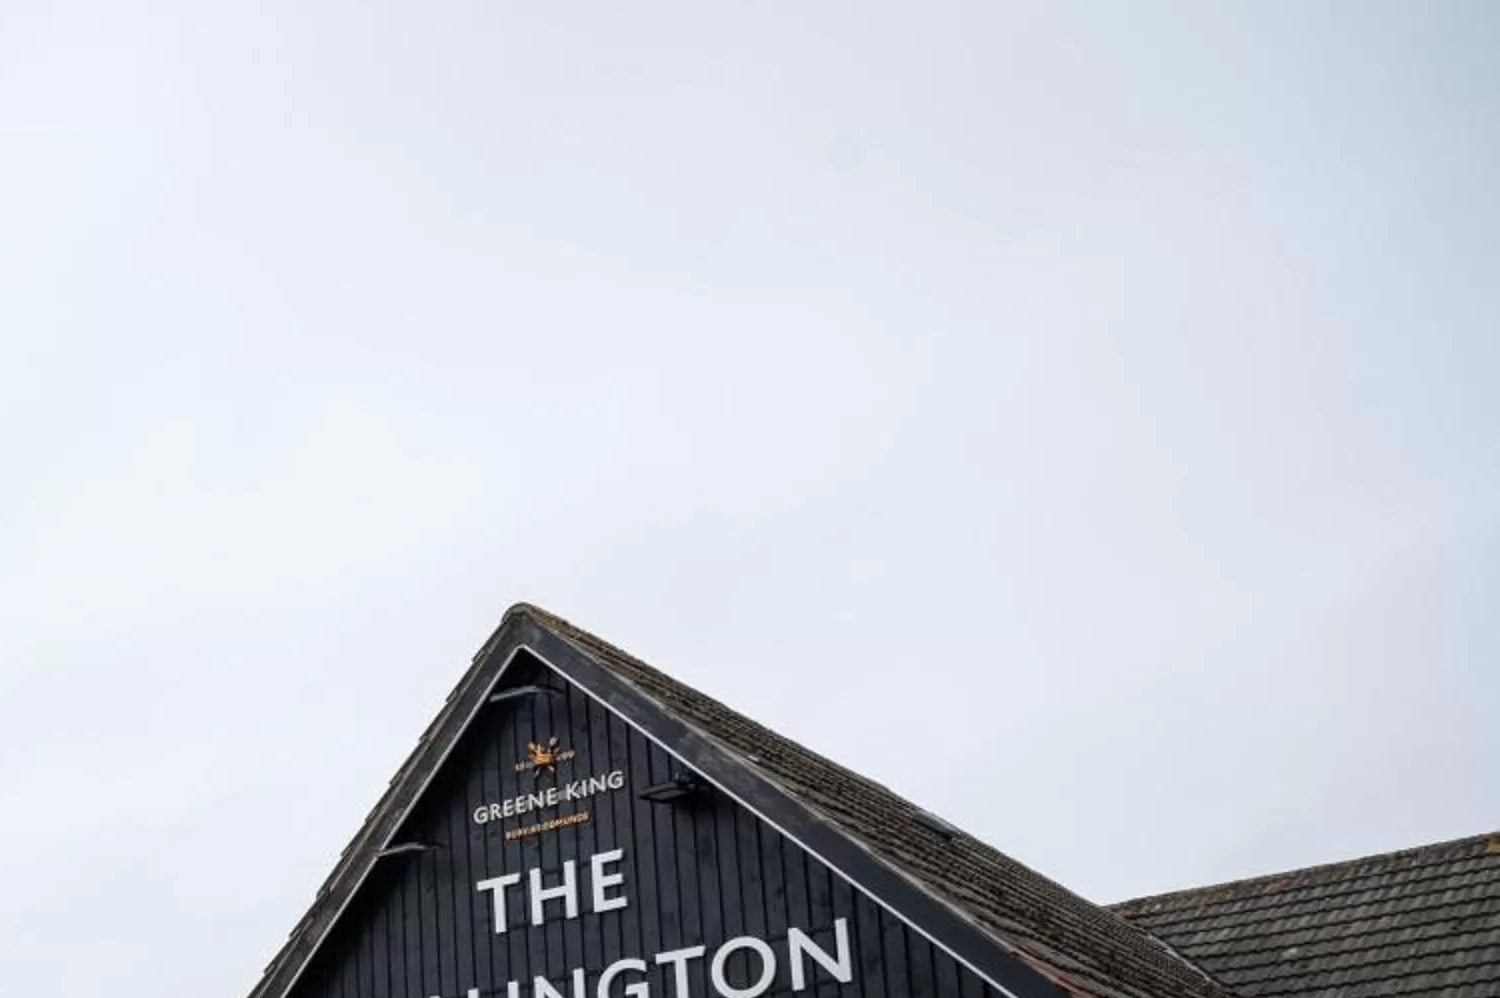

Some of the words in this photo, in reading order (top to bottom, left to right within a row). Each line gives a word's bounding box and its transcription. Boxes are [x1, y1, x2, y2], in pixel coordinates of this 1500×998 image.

[473, 787, 557, 824] GREENE
[566, 770, 624, 800] KING
[477, 848, 628, 933] THE
